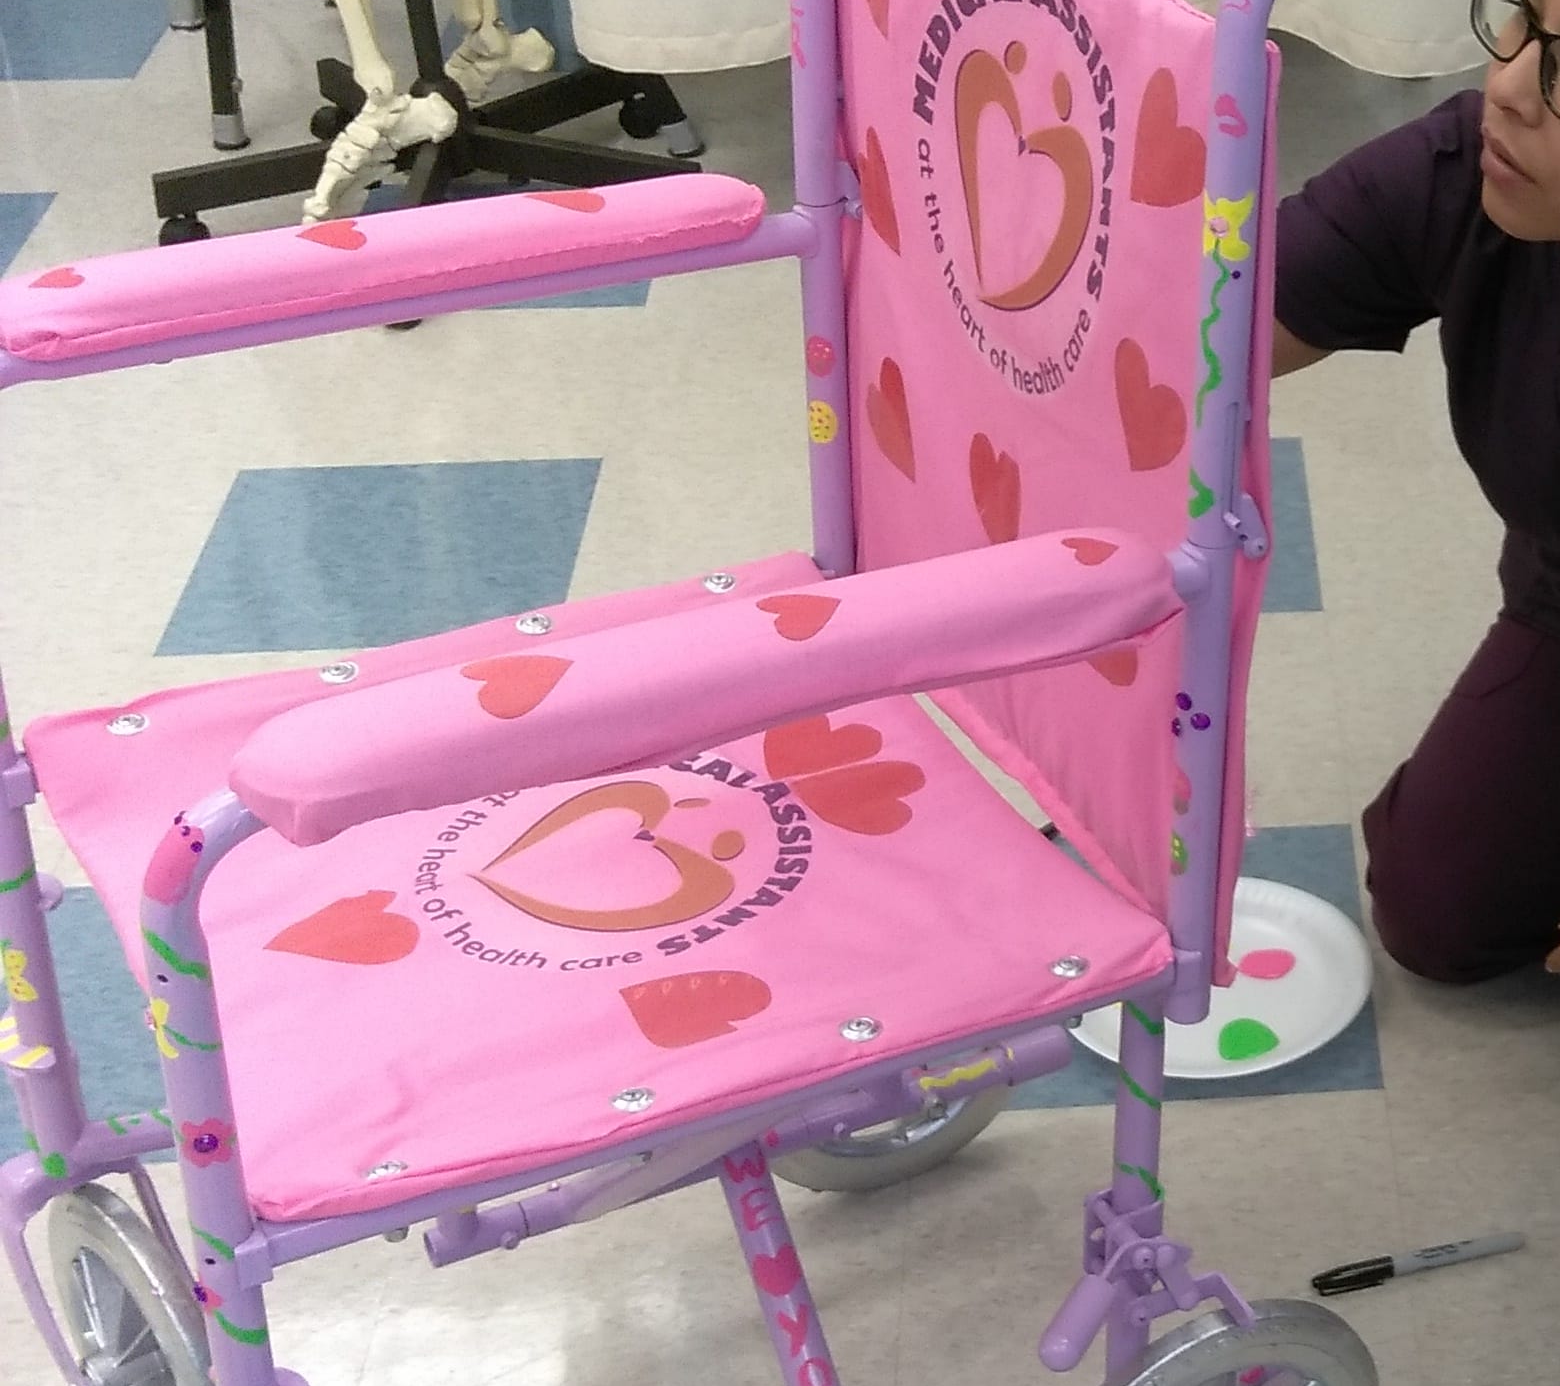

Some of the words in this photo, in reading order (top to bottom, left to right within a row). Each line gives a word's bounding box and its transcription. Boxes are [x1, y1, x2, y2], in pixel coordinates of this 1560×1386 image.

[917, 137, 936, 180] at
[923, 192, 946, 253] the
[942, 259, 987, 353] heart
[989, 347, 1008, 377] of
[1063, 308, 1092, 374] care
[1011, 356, 1065, 395] health
[437, 809, 488, 844] the
[413, 847, 457, 896] heart
[657, 781, 813, 957] ASSISTANTS
[423, 896, 463, 926] of
[445, 921, 548, 969] health
[560, 950, 642, 971] care
[723, 1147, 781, 1232] WE
